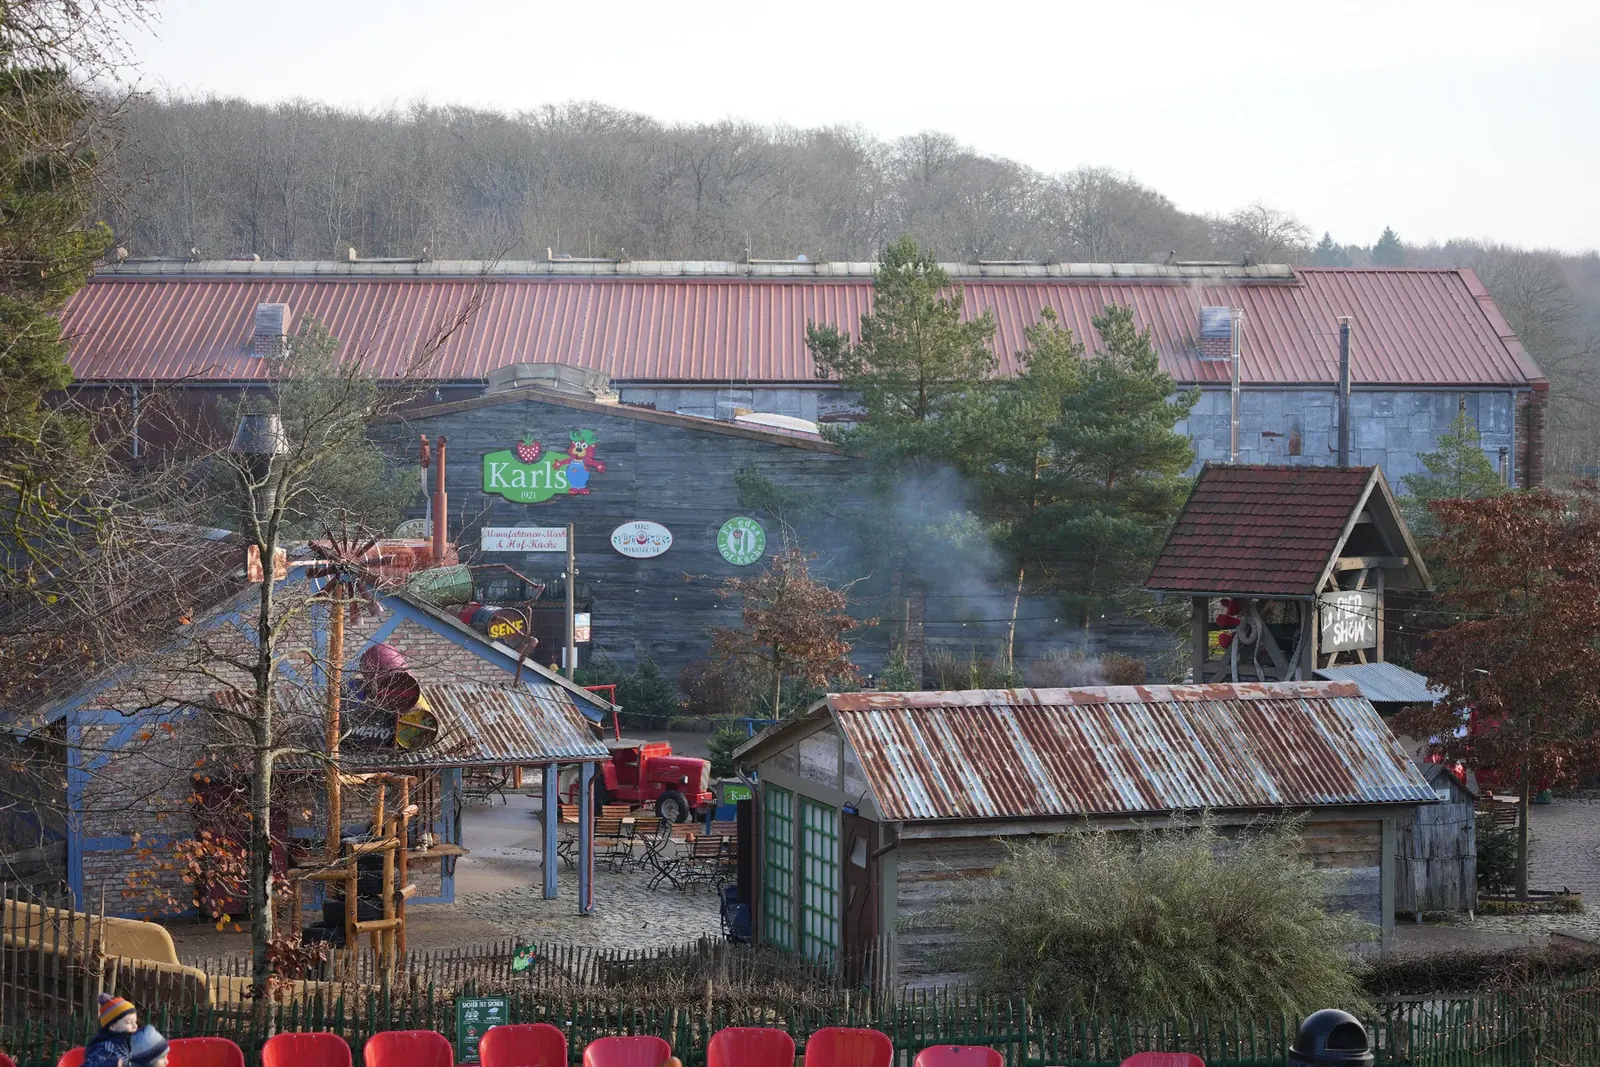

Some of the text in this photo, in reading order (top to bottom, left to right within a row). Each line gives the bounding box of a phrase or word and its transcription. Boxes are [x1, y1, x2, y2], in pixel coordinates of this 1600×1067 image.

[489, 461, 567, 489] Karls
[521, 491, 536, 499] 1921
[484, 529, 568, 540] Manufakturen-Mark
[496, 540, 504, 549] &
[1333, 613, 1367, 646] SHOW
[352, 725, 391, 740] MAYO
